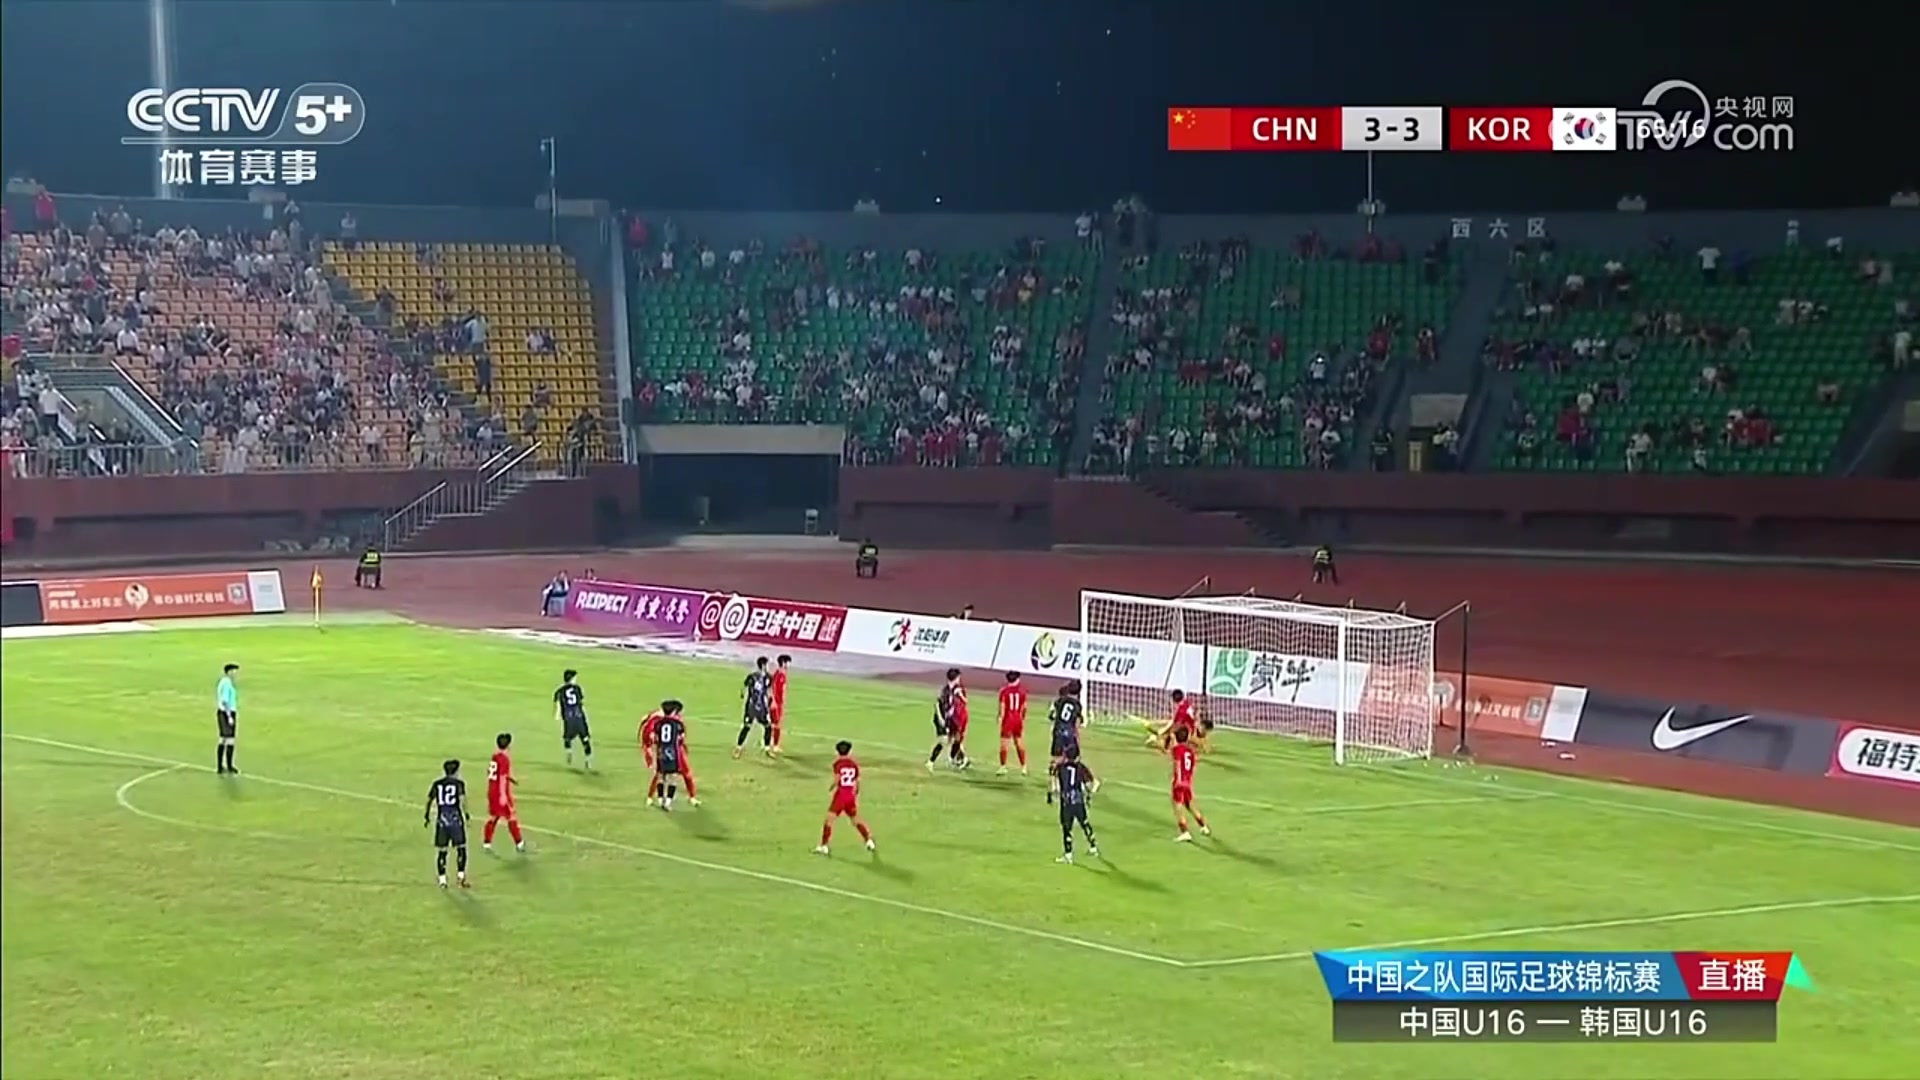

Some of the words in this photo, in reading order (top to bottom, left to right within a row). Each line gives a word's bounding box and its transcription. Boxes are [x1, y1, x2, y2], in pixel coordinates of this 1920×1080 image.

[1451, 218, 1546, 238] 西六区
[575, 591, 629, 613] RESPECT
[744, 607, 822, 641] 足球中国
[1062, 651, 1105, 673] PECE
[1106, 656, 1135, 676] CUP
[566, 688, 577, 704] 5
[1009, 692, 1020, 709] 11
[1061, 702, 1073, 720] 6
[660, 723, 672, 742] 8
[1184, 752, 1191, 770] 6
[840, 767, 856, 786] 22
[1067, 766, 1077, 786] 7
[437, 785, 456, 804] 12
